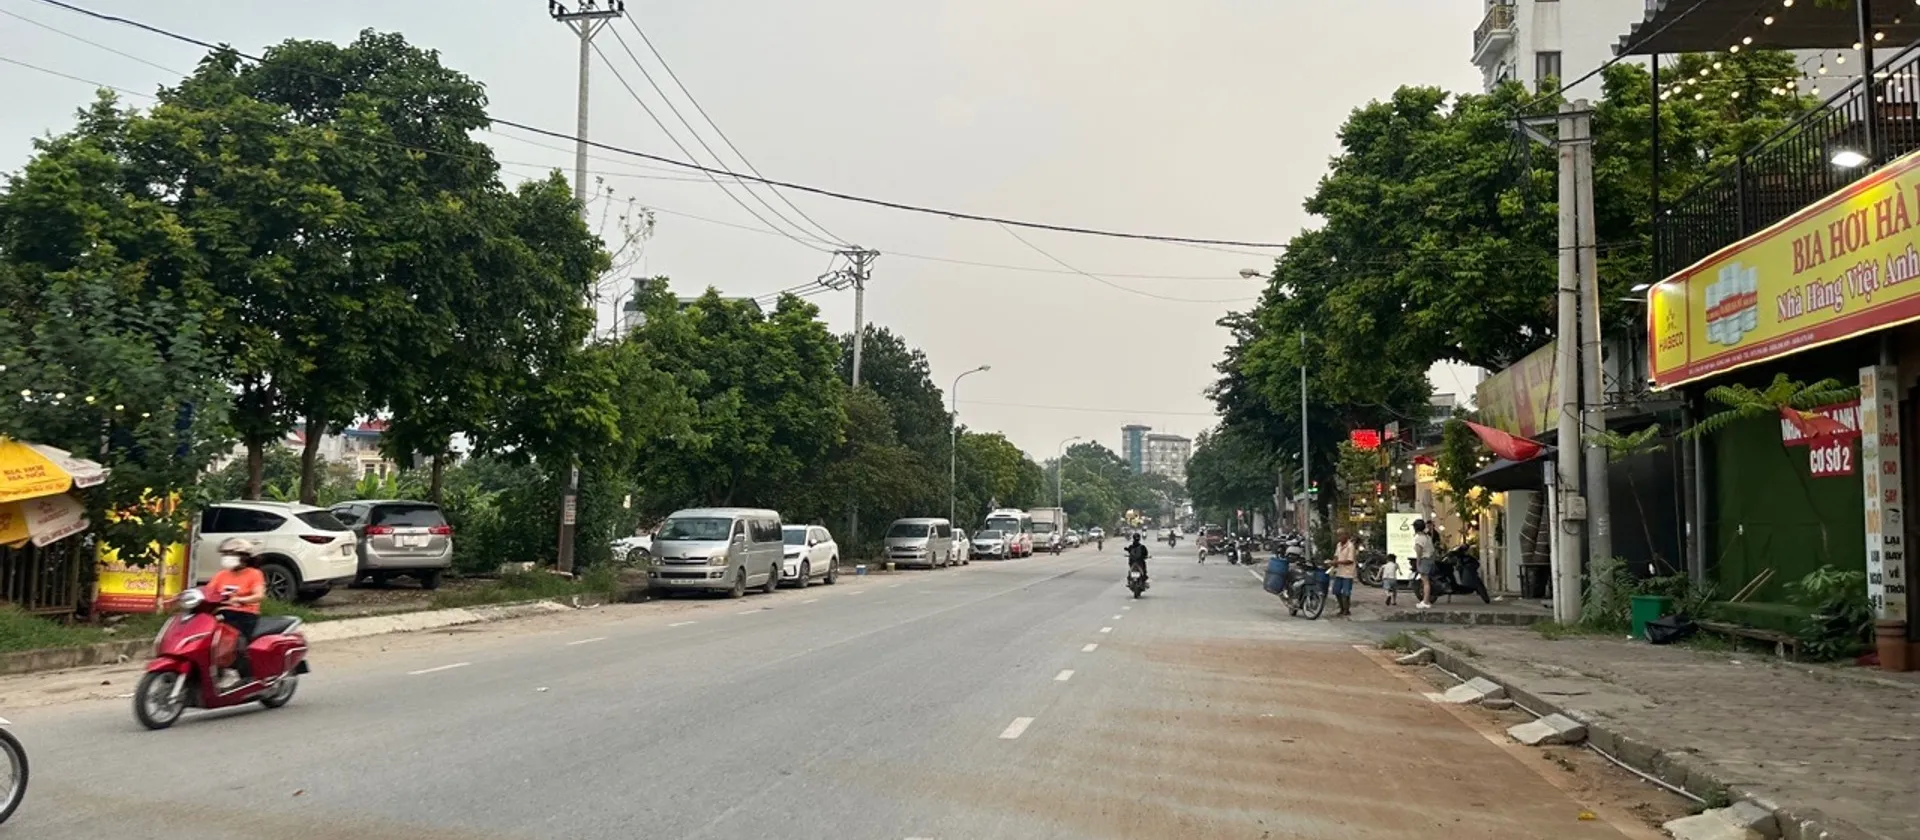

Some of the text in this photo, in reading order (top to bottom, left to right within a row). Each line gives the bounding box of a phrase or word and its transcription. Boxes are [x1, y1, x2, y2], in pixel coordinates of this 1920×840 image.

[1792, 229, 1826, 275] BIA
[1828, 208, 1870, 260] HƠI
[1874, 181, 1912, 242] HÀ
[1777, 285, 1803, 323] Nhà
[1805, 277, 1844, 313] Hàng
[1845, 258, 1880, 303] Việt
[1883, 242, 1920, 288] Anh
[1810, 439, 1851, 473] CƠ SỞ 2
[1885, 551, 1903, 560] BAY
